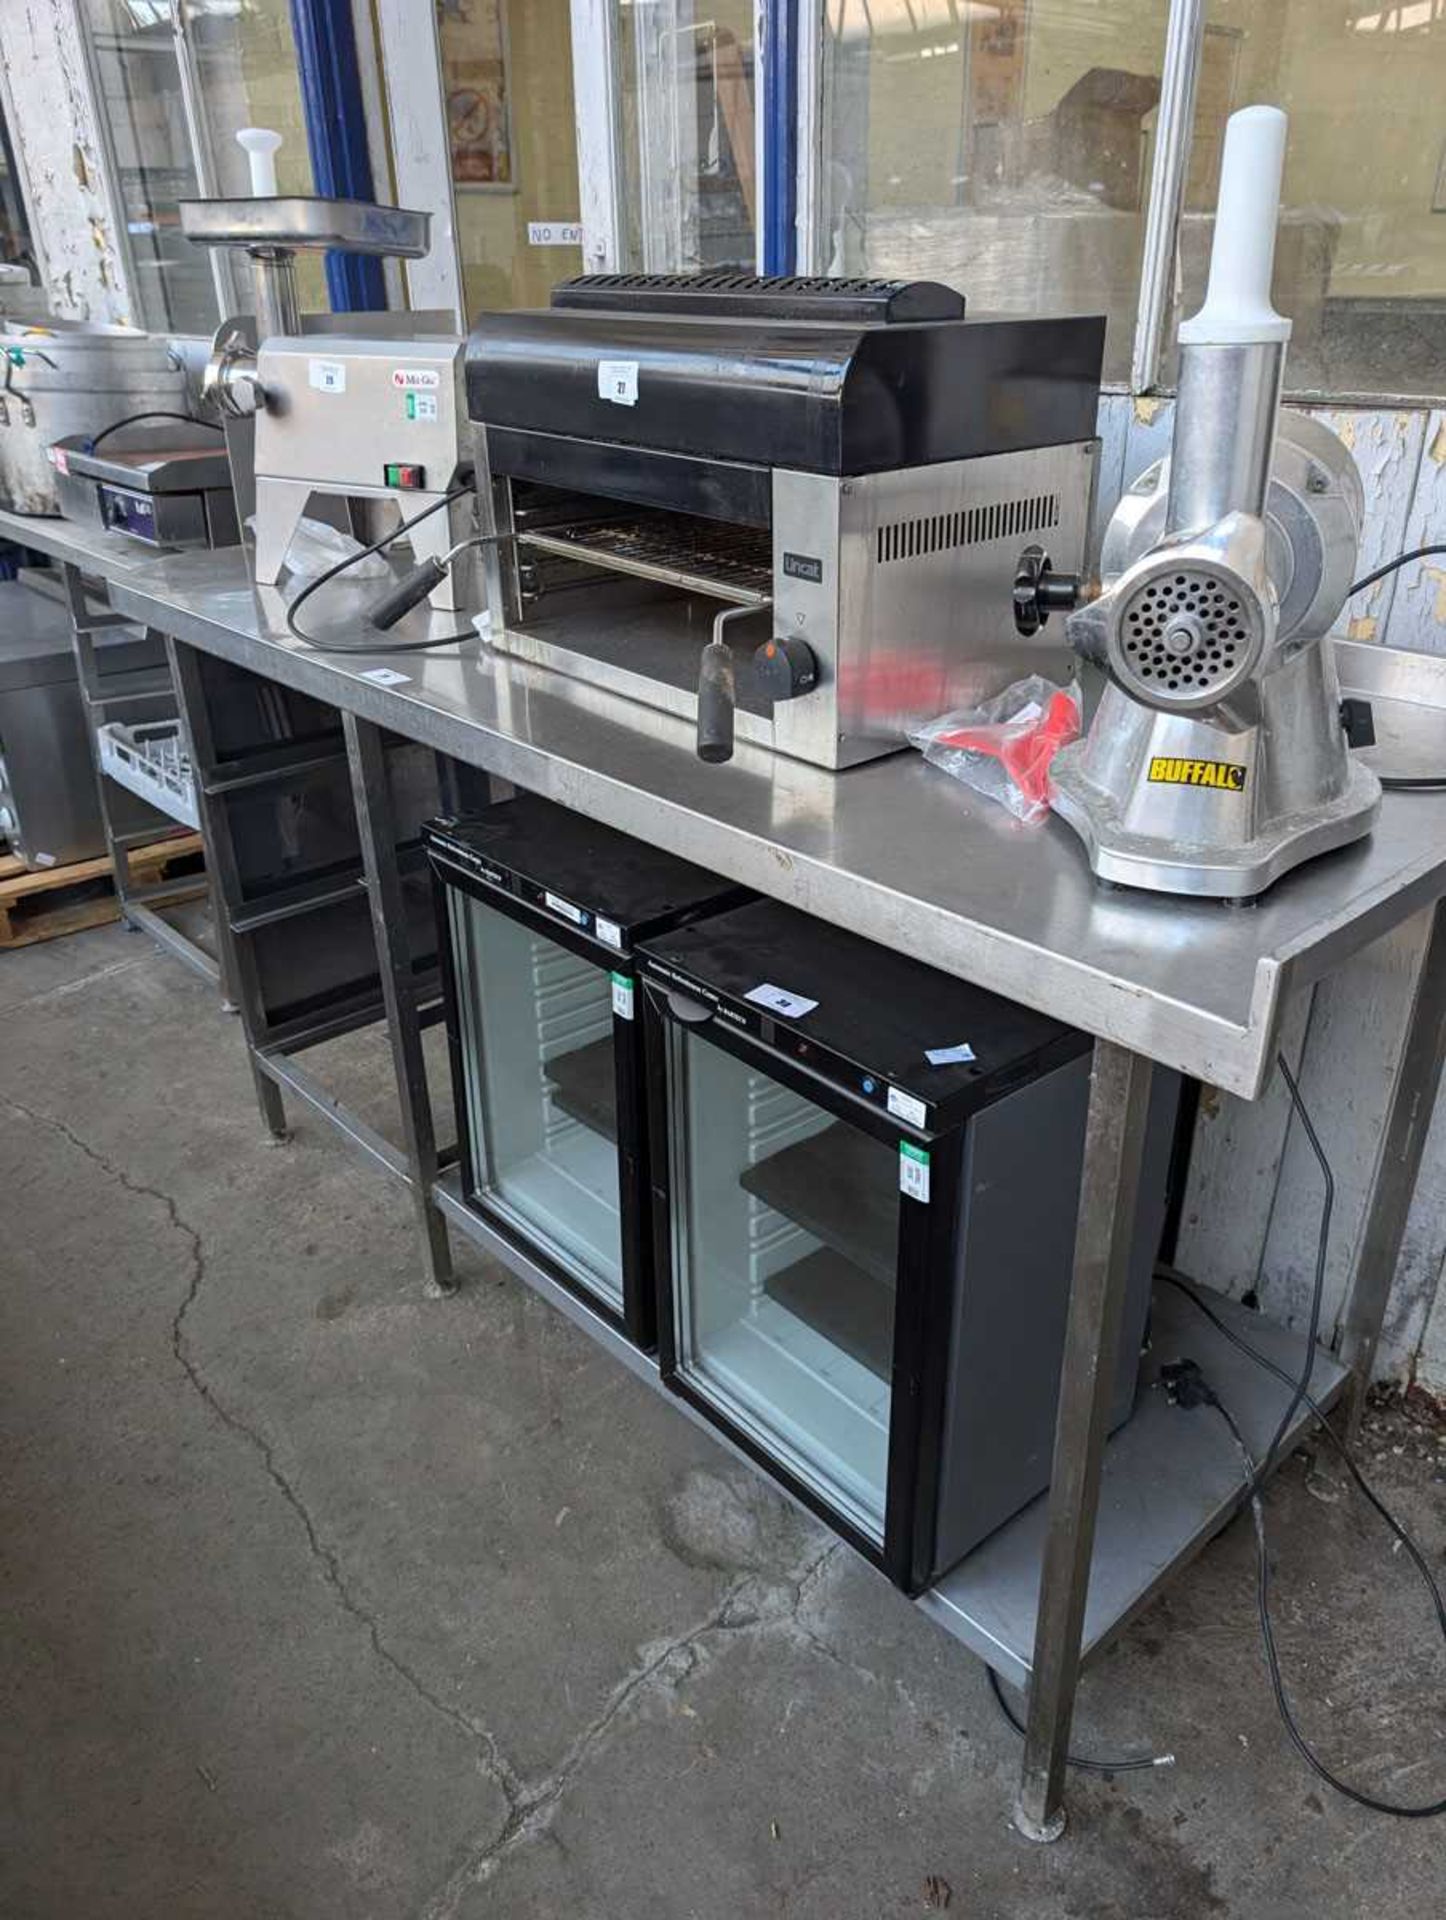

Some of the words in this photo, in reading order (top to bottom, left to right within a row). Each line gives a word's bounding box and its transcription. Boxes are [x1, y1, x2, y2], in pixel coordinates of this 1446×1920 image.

[532, 228, 552, 242] NO
[785, 555, 820, 580] Lincat
[1149, 758, 1244, 790] BUFFALO
